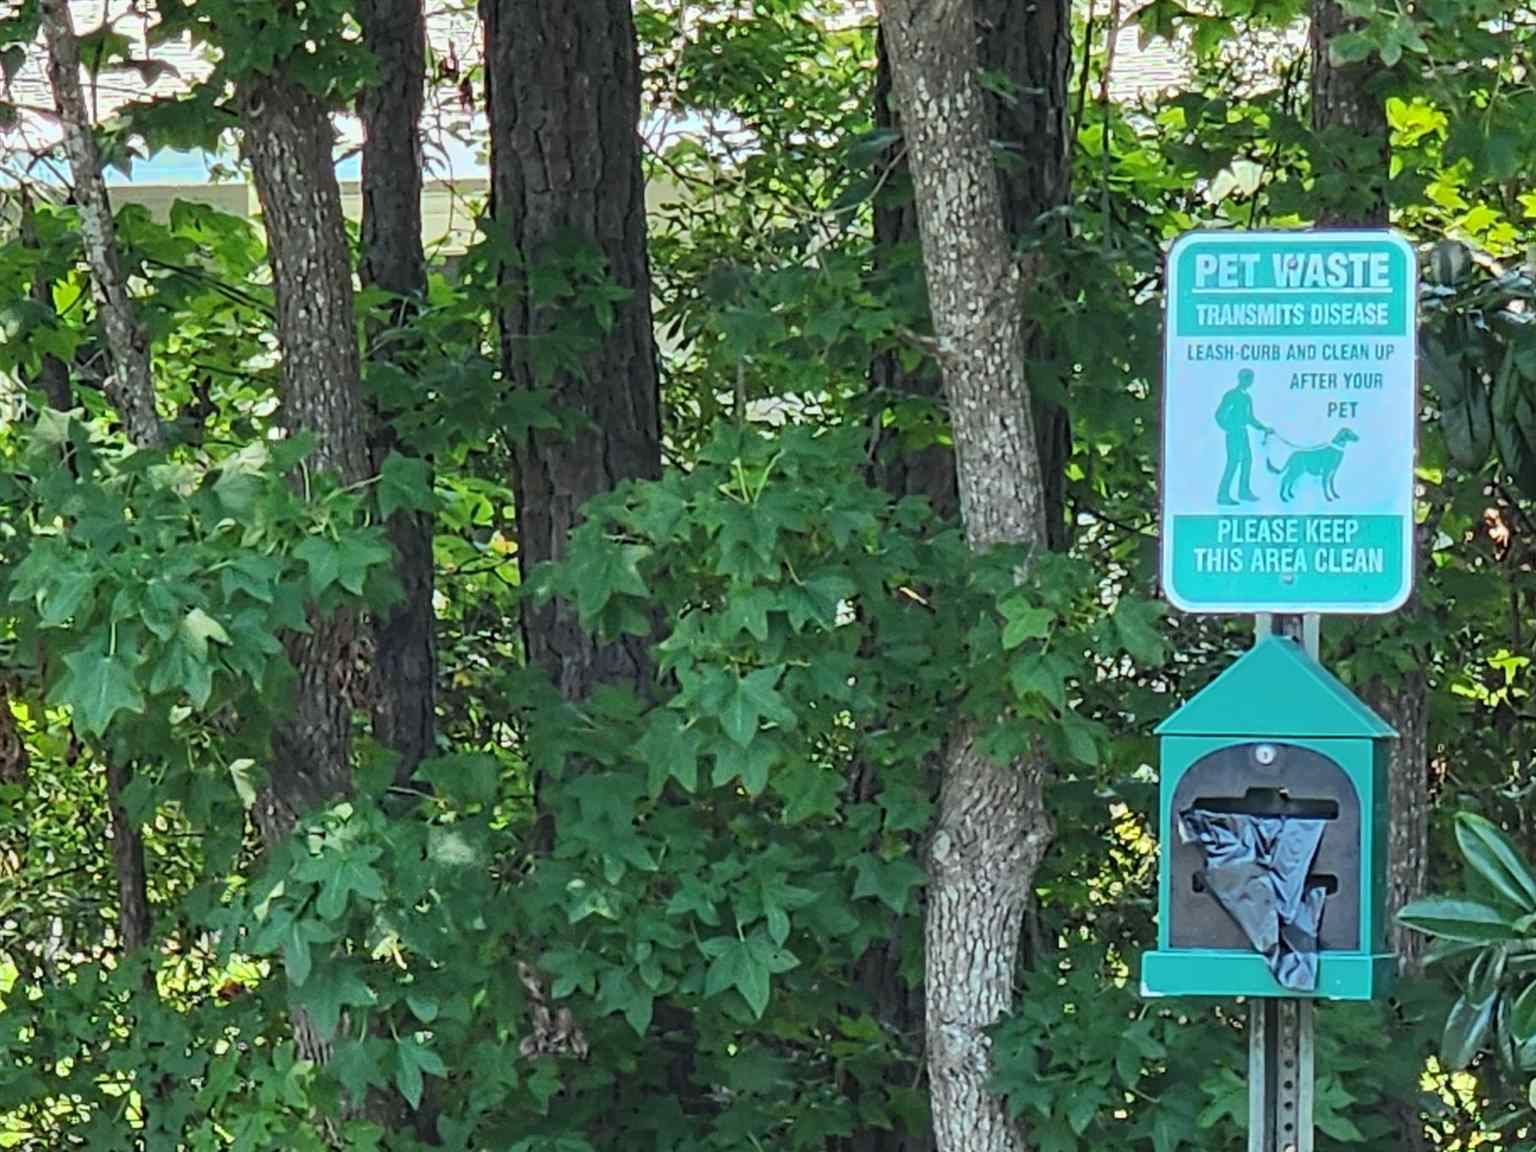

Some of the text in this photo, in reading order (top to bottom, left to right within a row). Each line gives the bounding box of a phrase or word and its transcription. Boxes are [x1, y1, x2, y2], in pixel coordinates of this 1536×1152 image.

[1195, 252, 1390, 288] PET WASTE
[1196, 303, 1388, 326] TRANSMITS DISEASE
[1187, 344, 1395, 361] LEASH-CURB AND CLEAN UP
[1290, 373, 1383, 389] AFTER YOUR
[1327, 402, 1358, 418] PET
[1217, 519, 1359, 543] PLEASE KEEP
[1193, 548, 1383, 573] THIS AREA CLEAN
